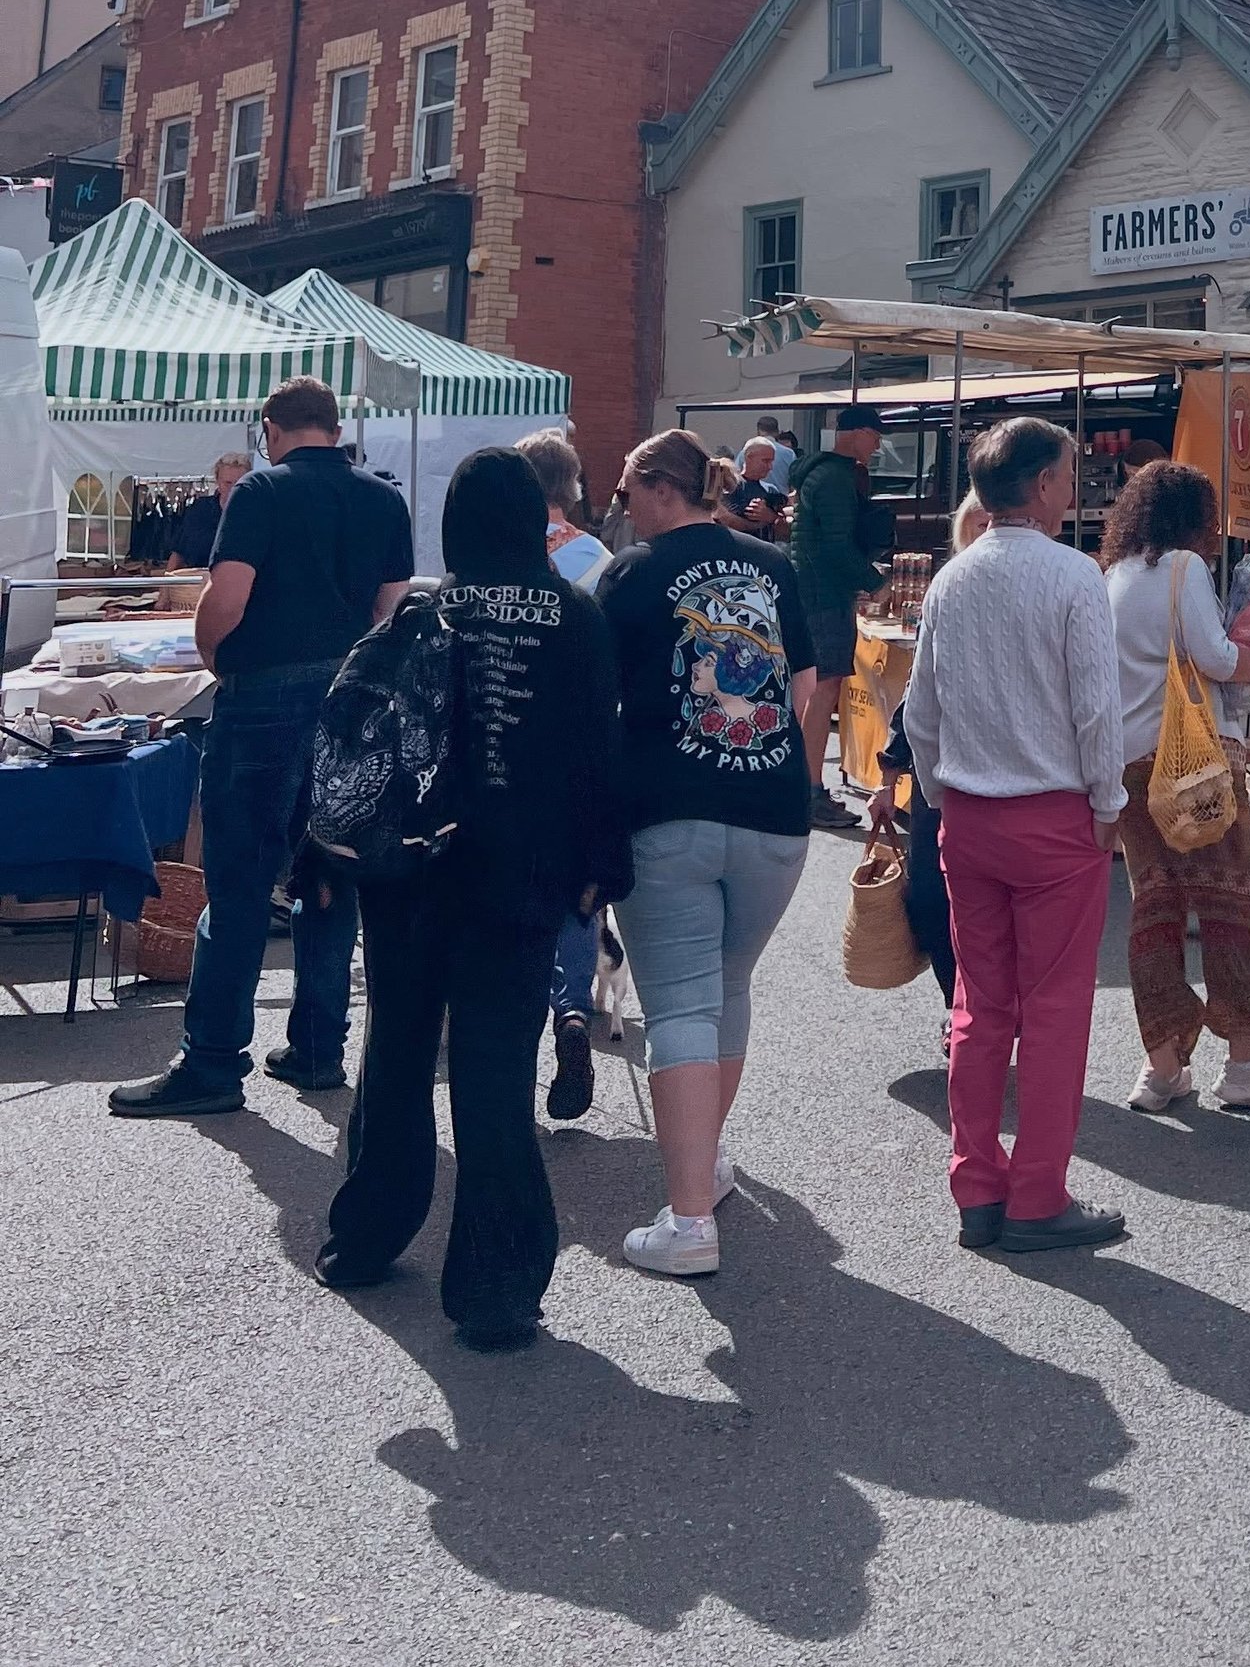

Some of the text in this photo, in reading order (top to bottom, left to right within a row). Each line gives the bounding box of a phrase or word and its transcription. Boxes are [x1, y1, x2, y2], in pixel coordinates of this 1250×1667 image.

[1102, 200, 1223, 252] FARMERS'
[1103, 256, 1132, 266] Makers
[1173, 248, 1190, 258] and
[1191, 245, 1216, 256] balms
[1234, 410, 1245, 452] 7
[440, 586, 560, 606] YUNGBLUD
[667, 560, 781, 601] DON'T RAIN ON
[676, 736, 792, 772] MY PARADE
